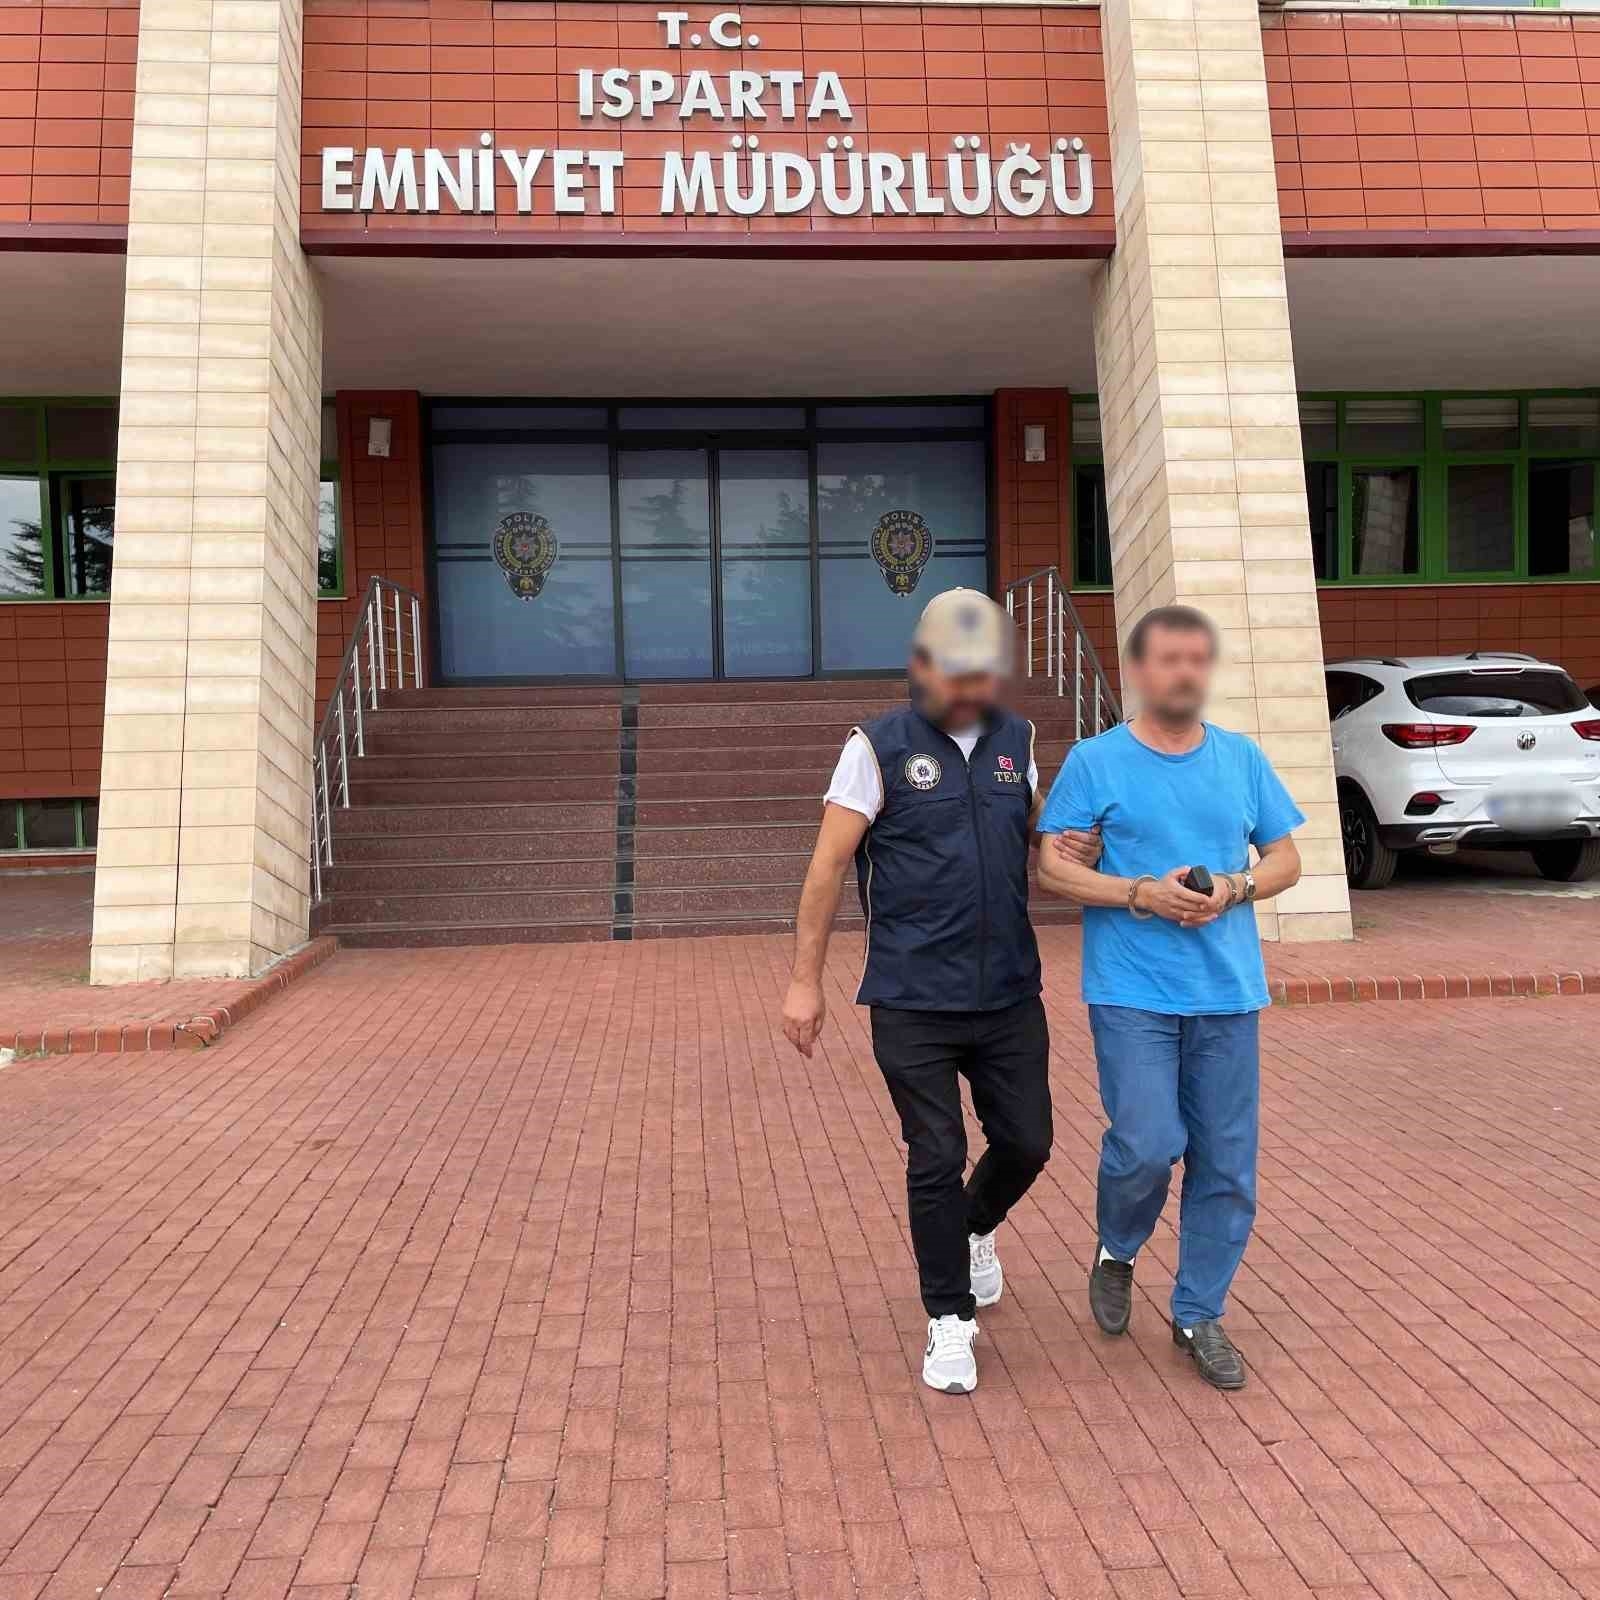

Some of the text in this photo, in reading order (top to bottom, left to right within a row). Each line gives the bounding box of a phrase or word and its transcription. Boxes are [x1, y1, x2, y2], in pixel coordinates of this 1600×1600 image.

[656, 12, 761, 48] T.C.
[578, 68, 853, 120] ISPARTA
[322, 132, 1094, 216] EMNİYET MÜDÜRLÜĞÜ
[994, 771, 1022, 784] TEM
